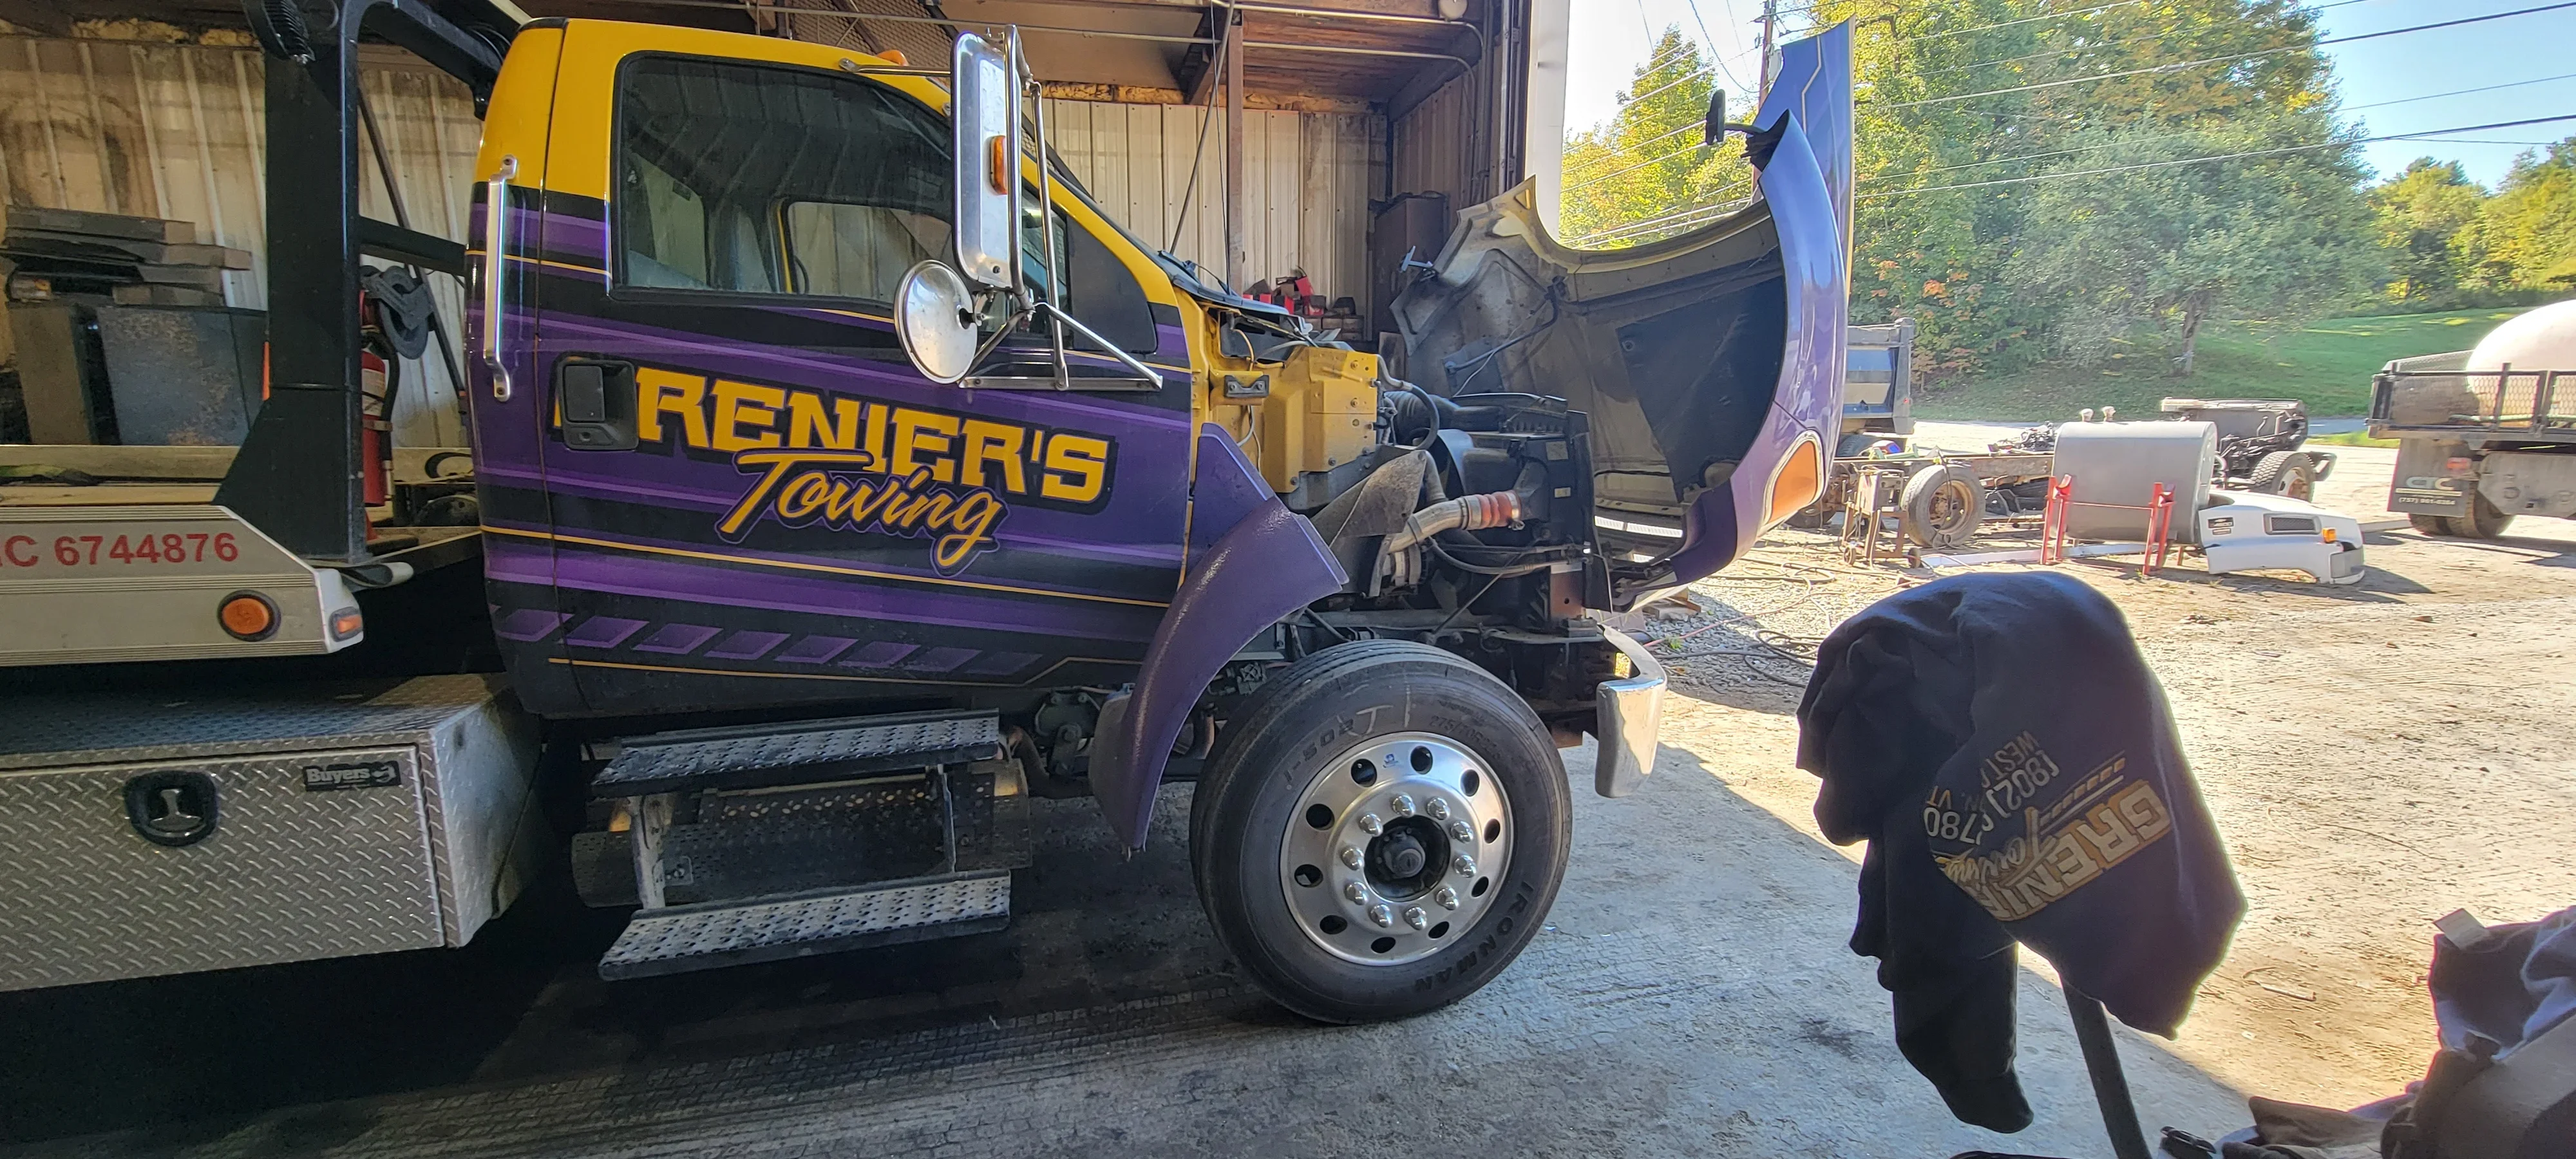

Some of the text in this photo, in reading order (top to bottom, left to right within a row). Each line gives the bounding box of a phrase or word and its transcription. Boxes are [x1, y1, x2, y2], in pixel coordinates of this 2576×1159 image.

[554, 358, 1108, 502] RENIER'S
[0, 532, 238, 567] C 6744876
[721, 451, 1005, 569] Towing
[306, 768, 371, 784] Buyers
[1415, 880, 1534, 992] IRONMAN
